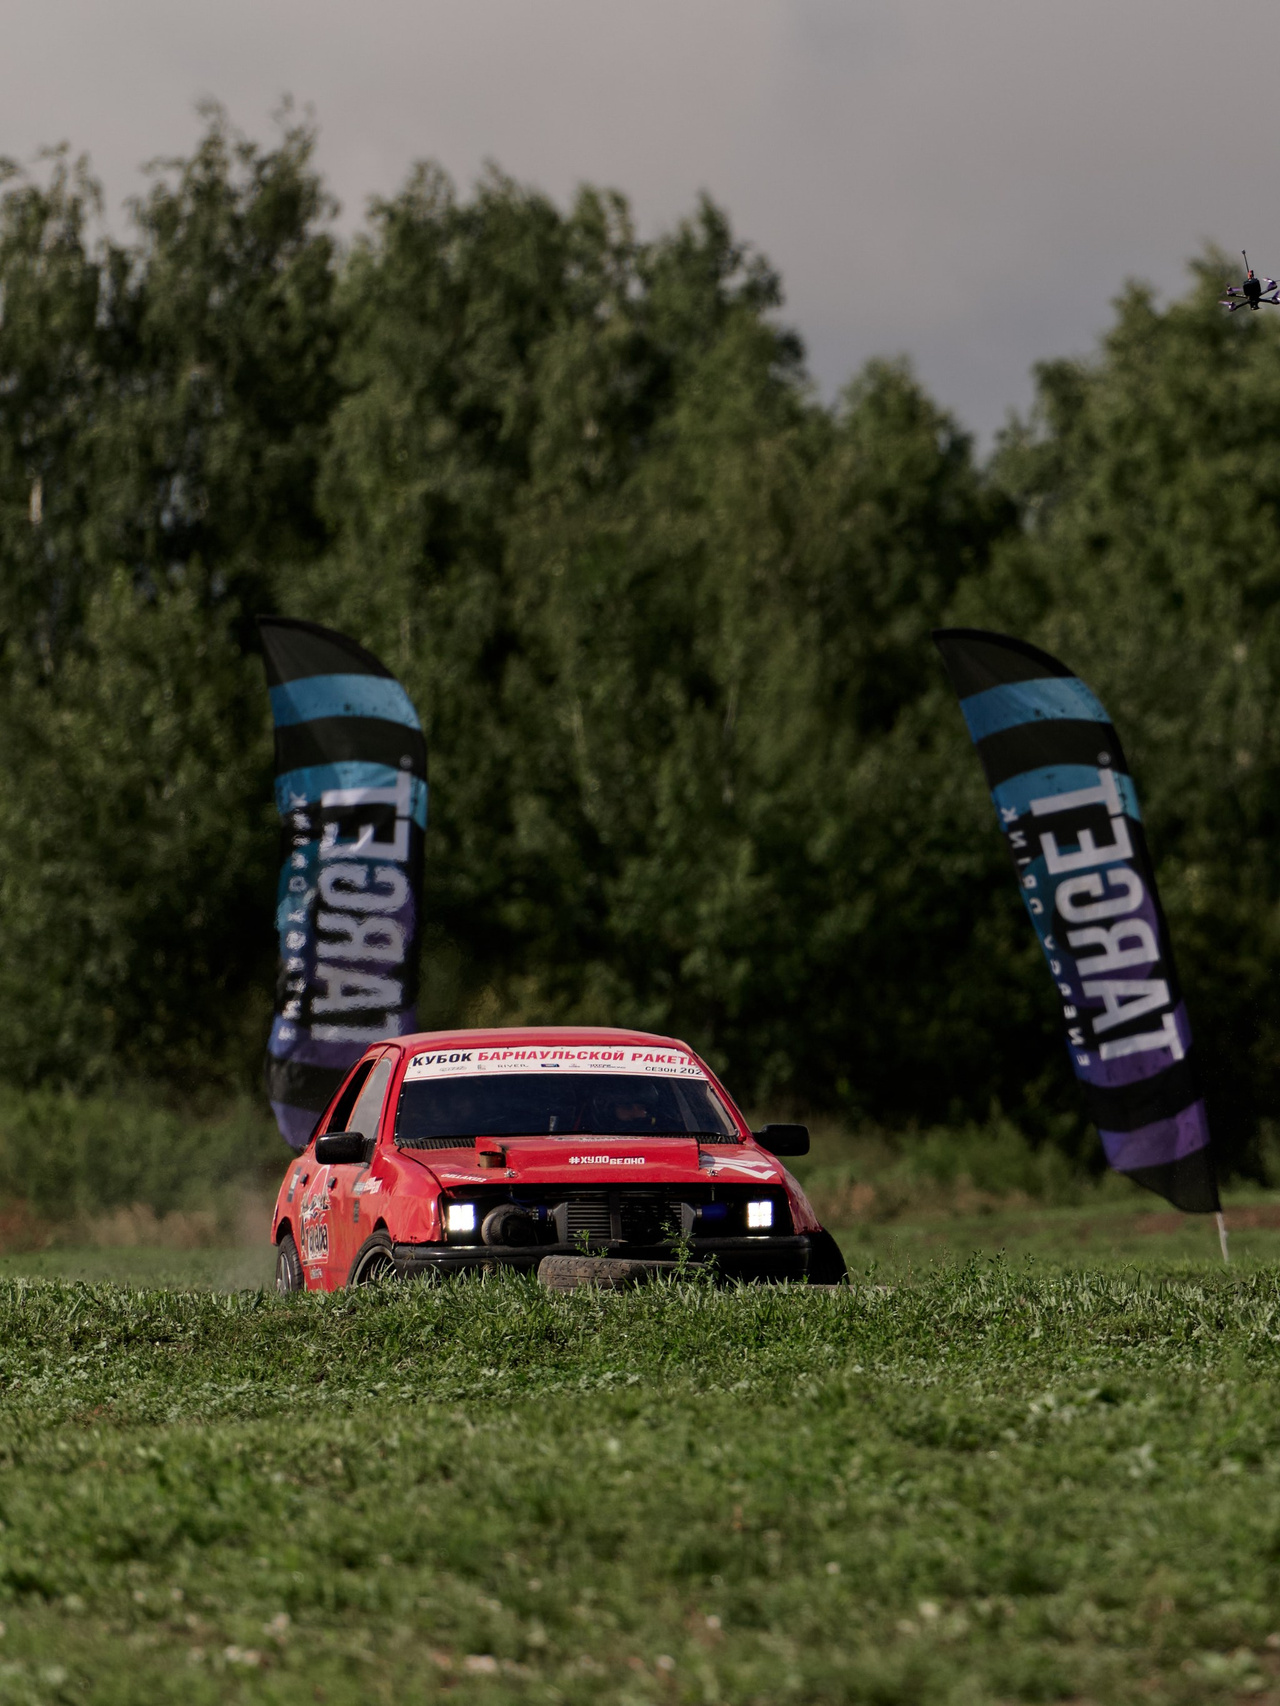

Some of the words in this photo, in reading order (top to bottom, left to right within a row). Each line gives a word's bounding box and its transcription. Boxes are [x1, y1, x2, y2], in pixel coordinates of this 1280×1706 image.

[413, 1053, 473, 1066] КУБОК
[478, 1050, 624, 1061] БАРНАУЛЬСКОЙ
[680, 1067, 703, 1075] 202
